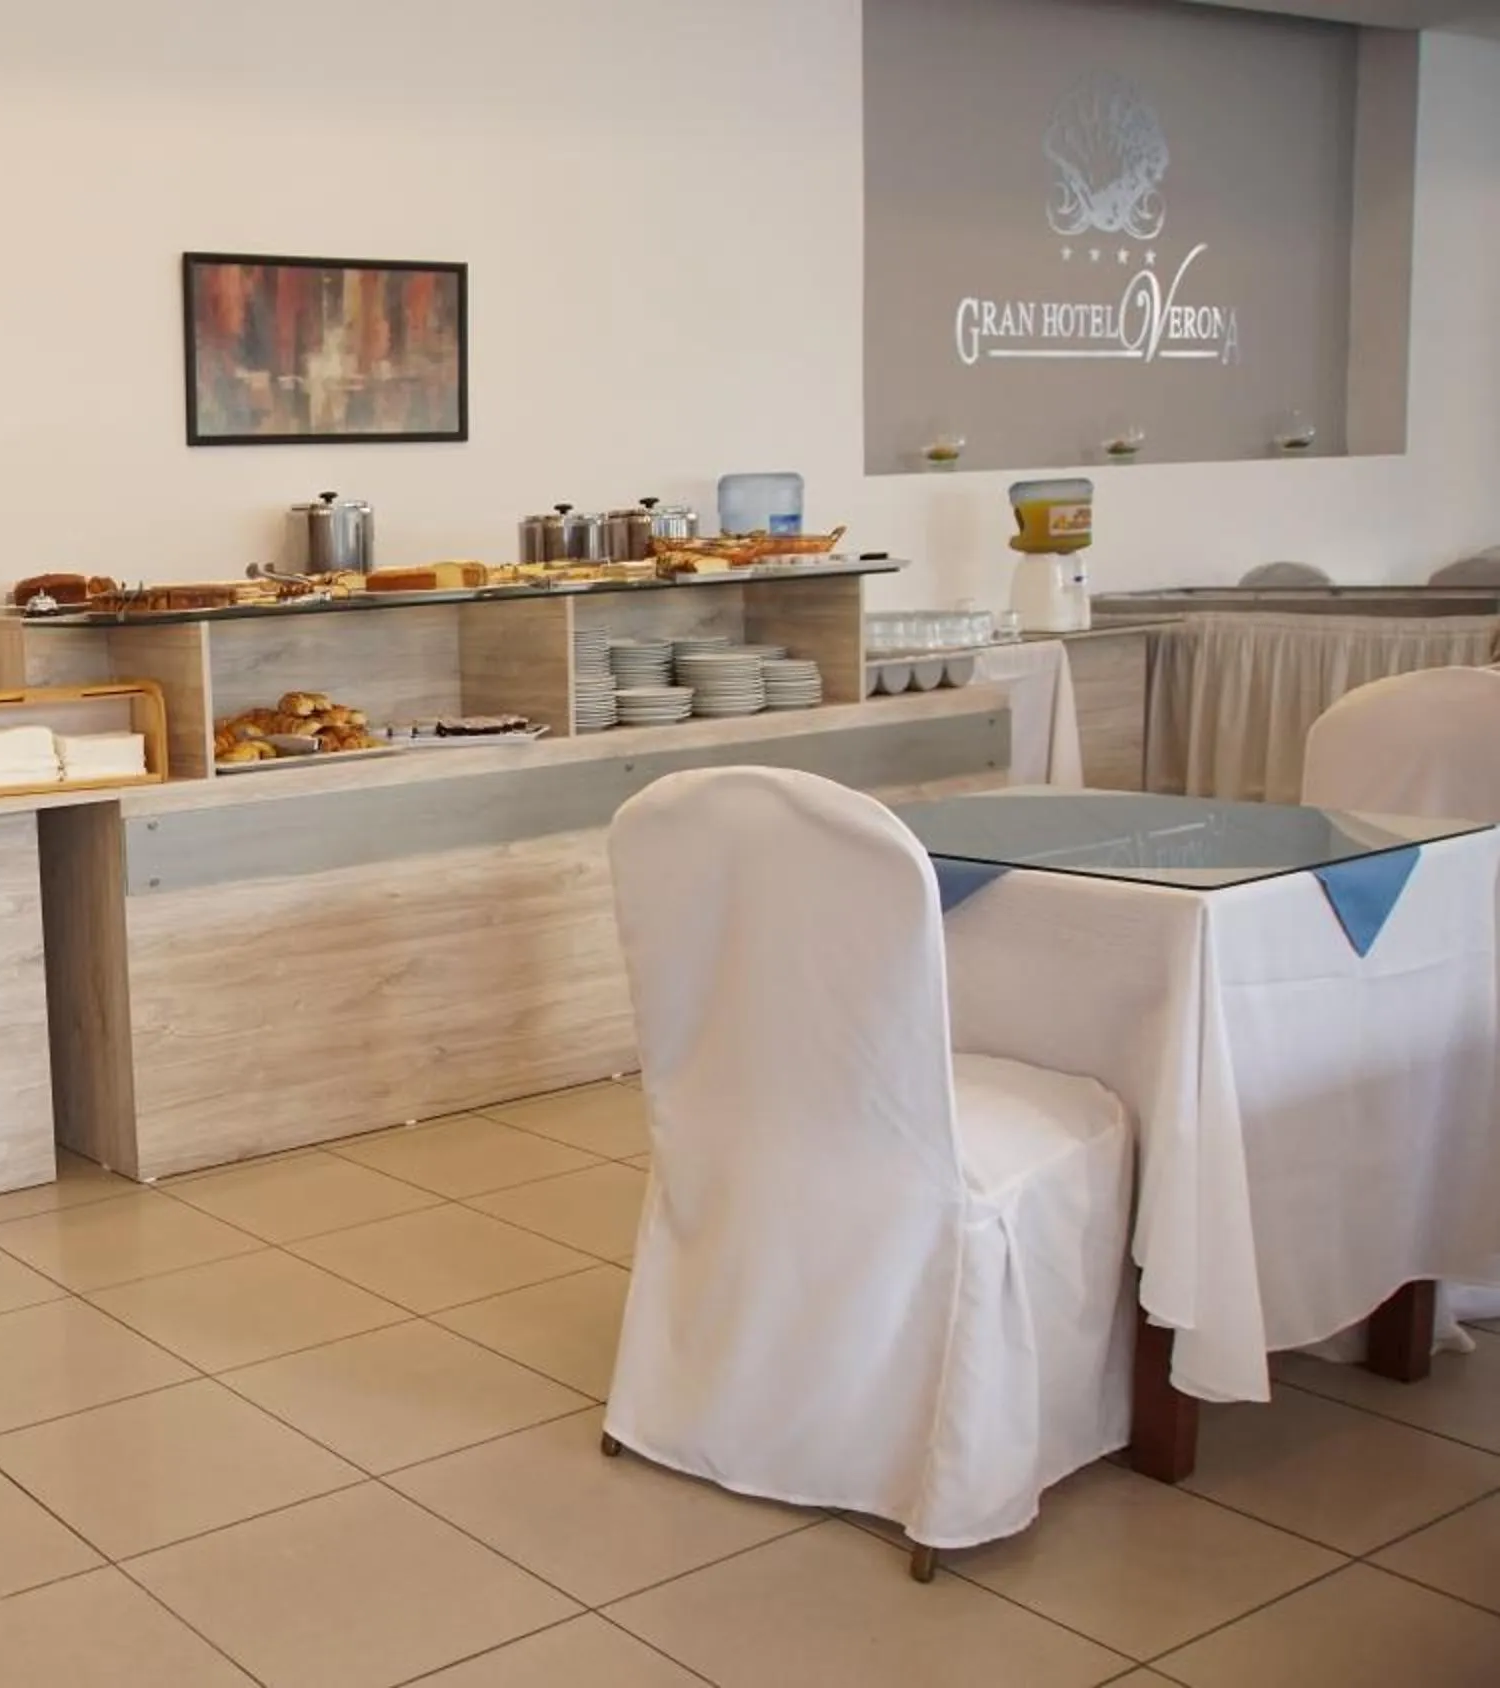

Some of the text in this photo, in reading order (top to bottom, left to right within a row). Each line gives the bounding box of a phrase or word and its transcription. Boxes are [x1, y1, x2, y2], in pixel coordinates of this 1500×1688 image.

[955, 242, 1240, 366] GRAN HOTEL VERONA
